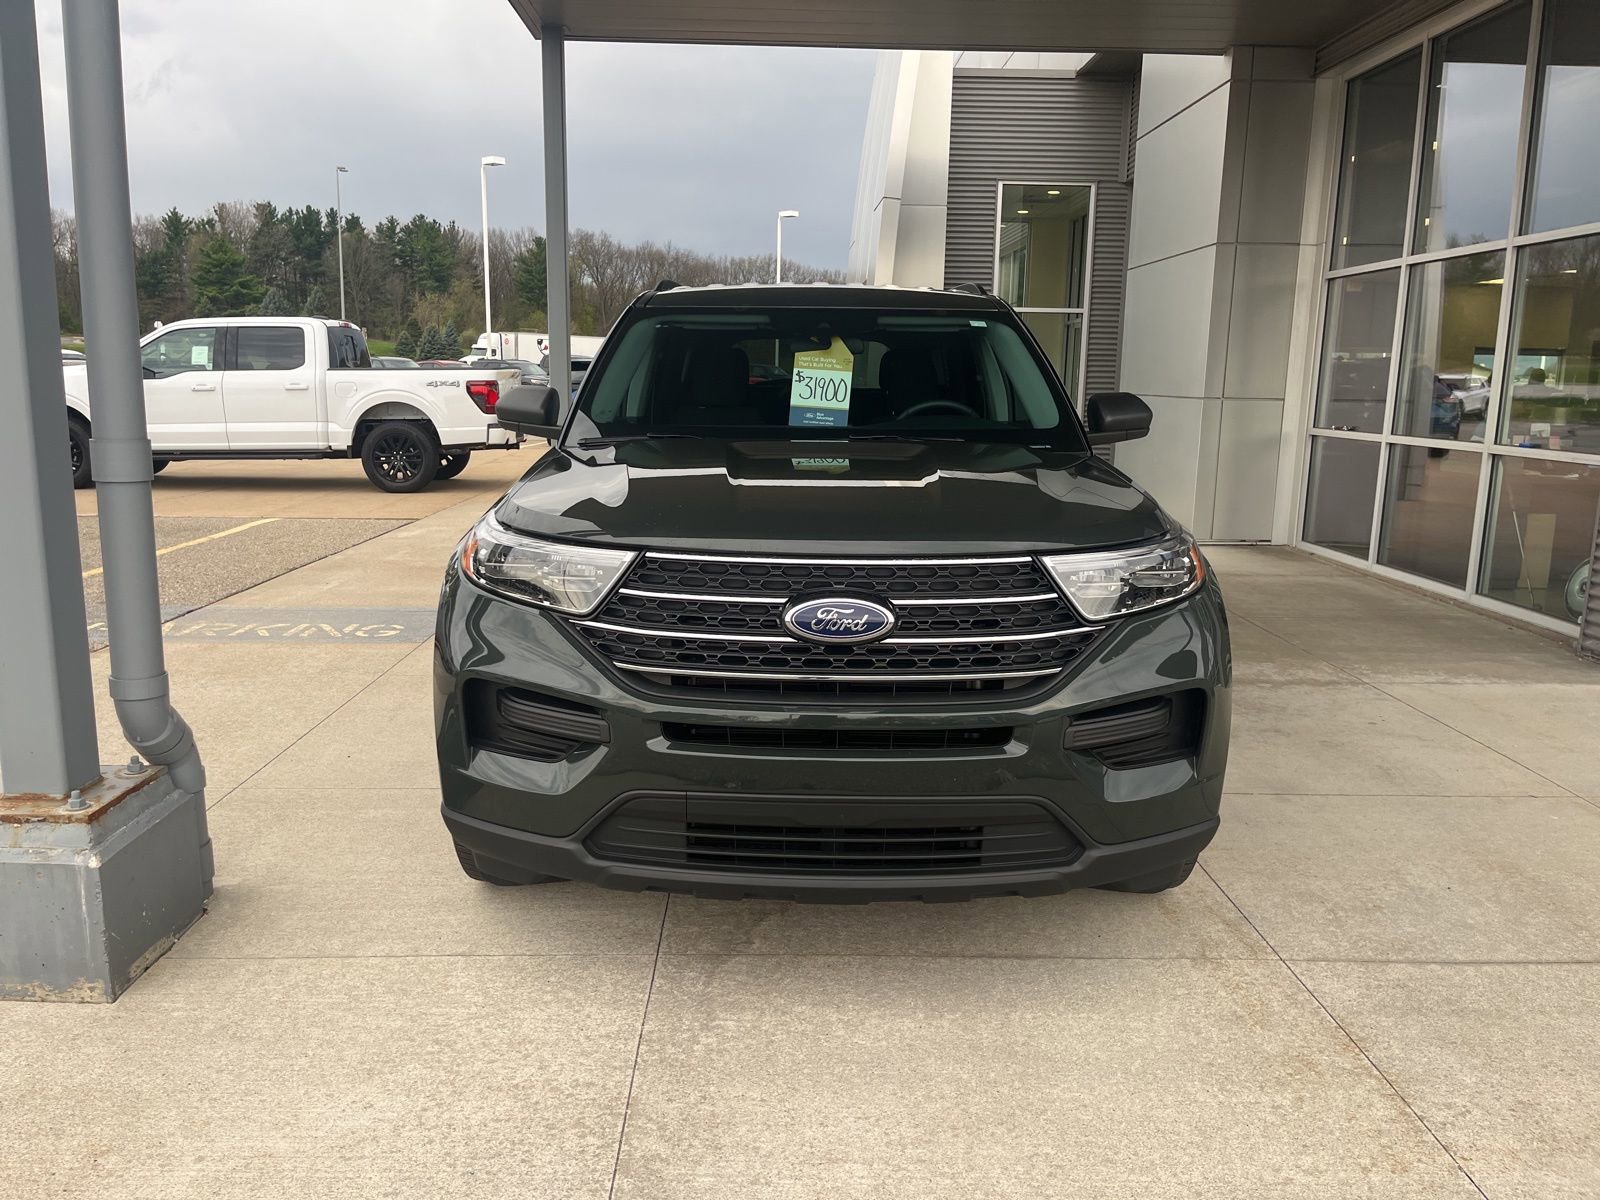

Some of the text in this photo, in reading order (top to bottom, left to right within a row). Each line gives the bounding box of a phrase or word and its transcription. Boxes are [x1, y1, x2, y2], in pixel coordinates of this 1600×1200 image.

[794, 369, 848, 403] $31900
[87, 622, 405, 637] RKING
[811, 607, 869, 631] Ford
